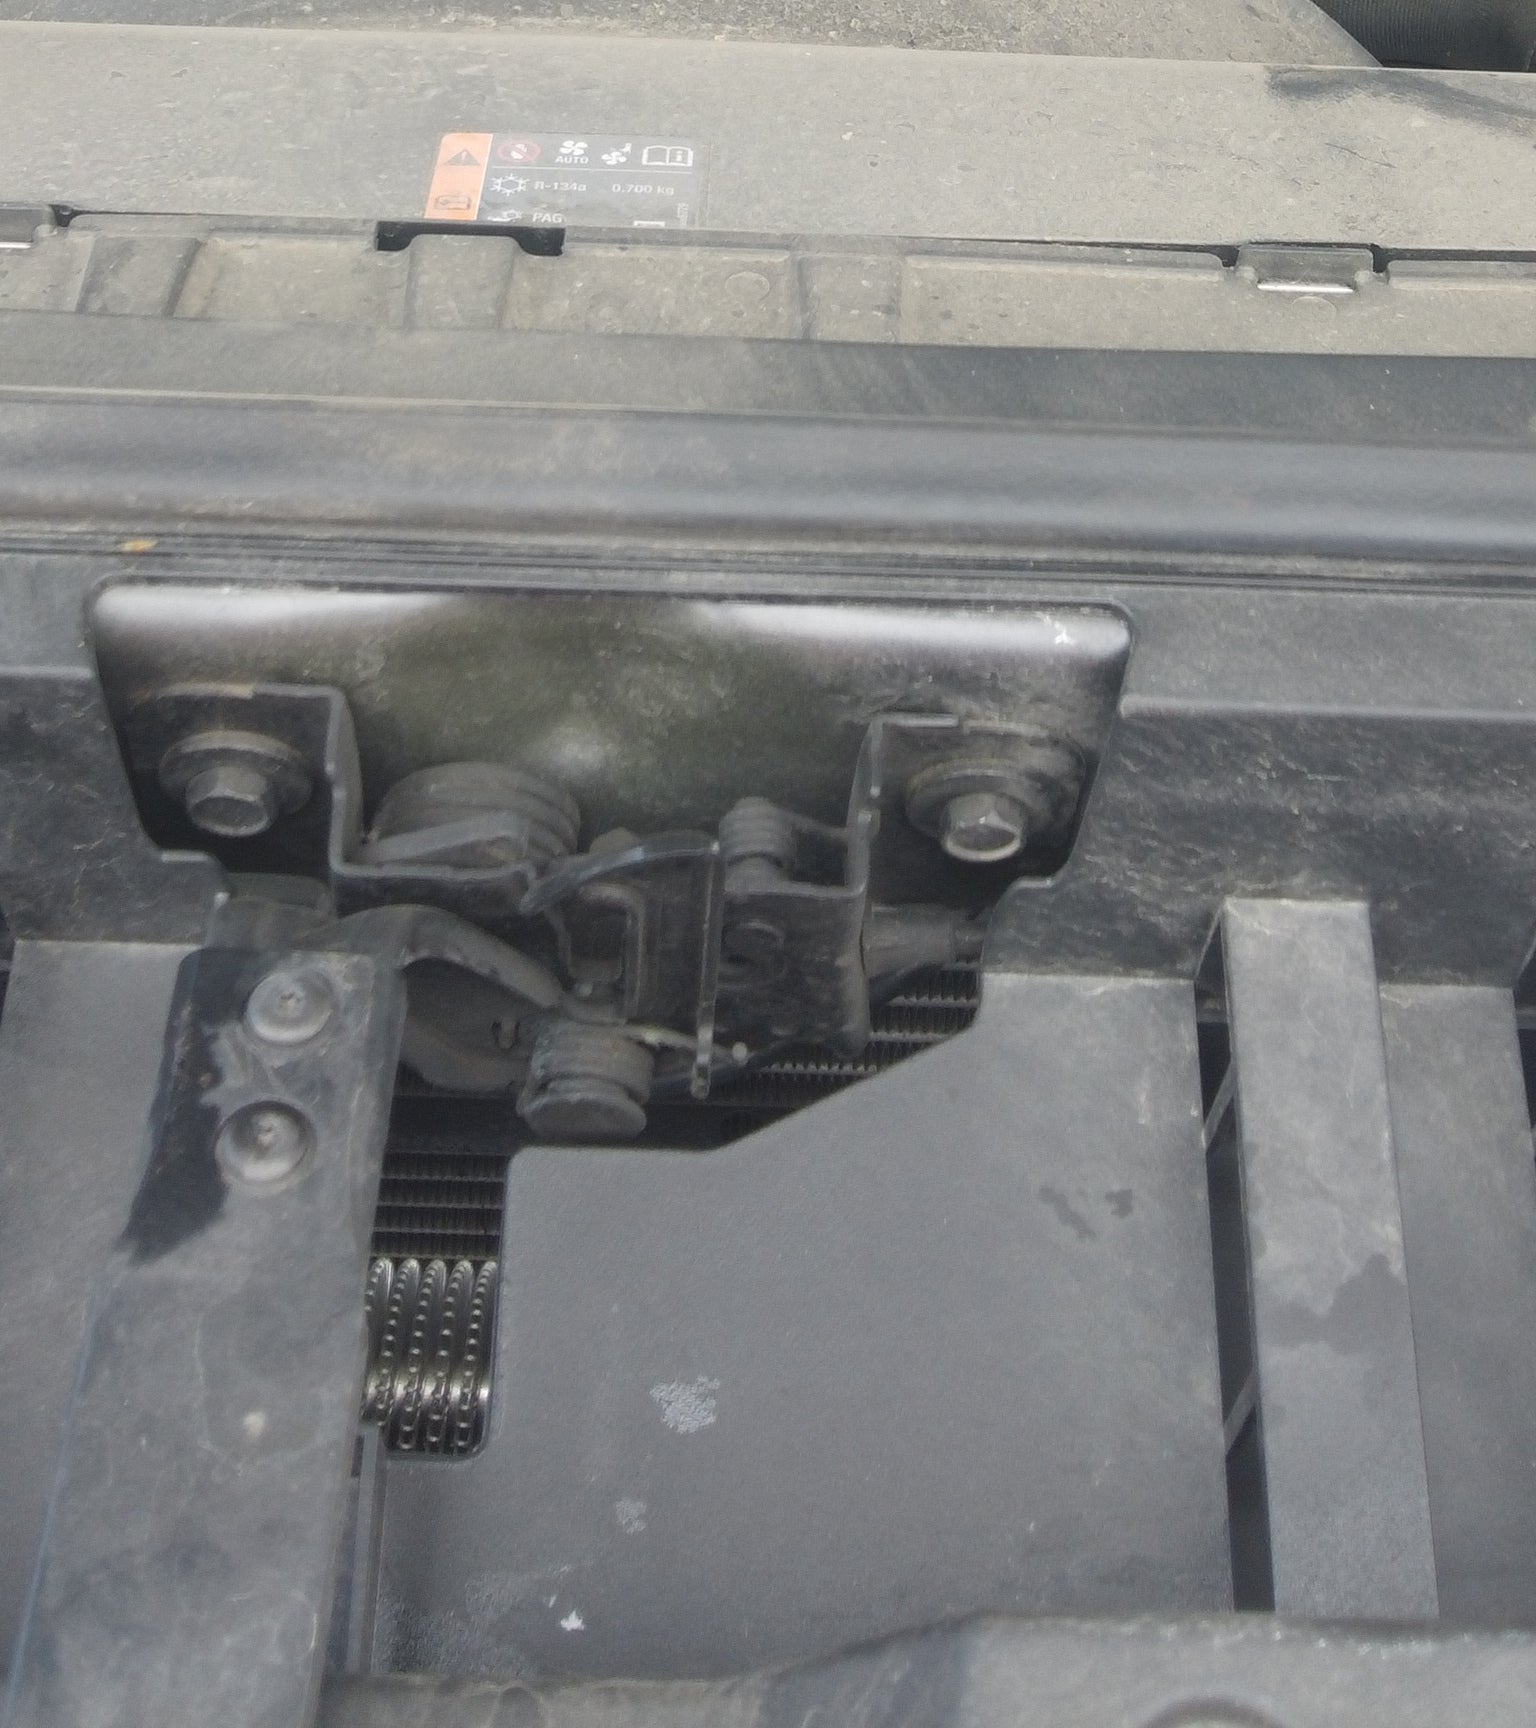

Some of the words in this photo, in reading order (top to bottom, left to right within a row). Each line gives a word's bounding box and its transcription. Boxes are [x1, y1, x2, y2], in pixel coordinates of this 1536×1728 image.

[555, 155, 589, 164] AUTO
[534, 181, 587, 192] R-134a
[612, 184, 653, 194] 0.700
[657, 185, 675, 196] kg
[532, 212, 564, 223] PAG
